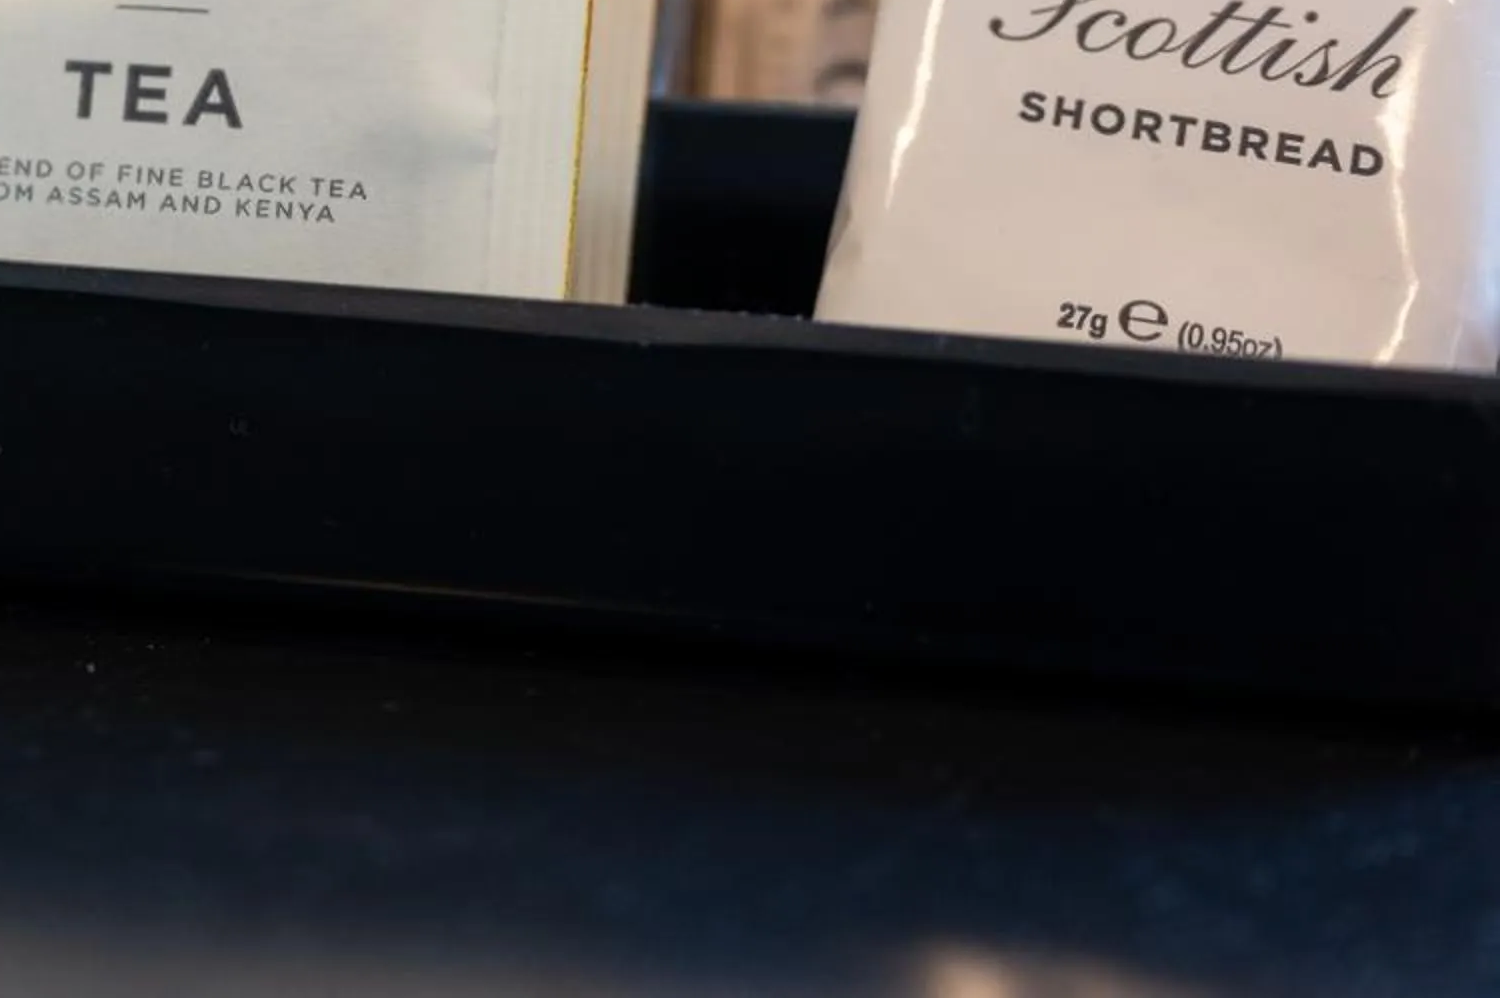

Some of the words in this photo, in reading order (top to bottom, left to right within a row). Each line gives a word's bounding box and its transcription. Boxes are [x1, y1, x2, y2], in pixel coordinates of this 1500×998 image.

[64, 60, 243, 129] TEA
[1017, 91, 1385, 178] SHORTBREAD
[45, 185, 147, 211] ASSAM
[159, 192, 222, 216] AND
[234, 198, 336, 224] KENYA
[66, 160, 106, 182] OF
[116, 163, 184, 188] FINE
[197, 169, 297, 195] BLACK
[310, 176, 368, 201] TEA
[1056, 301, 1108, 340] 27g
[1177, 319, 1284, 361] (0.95oz)
